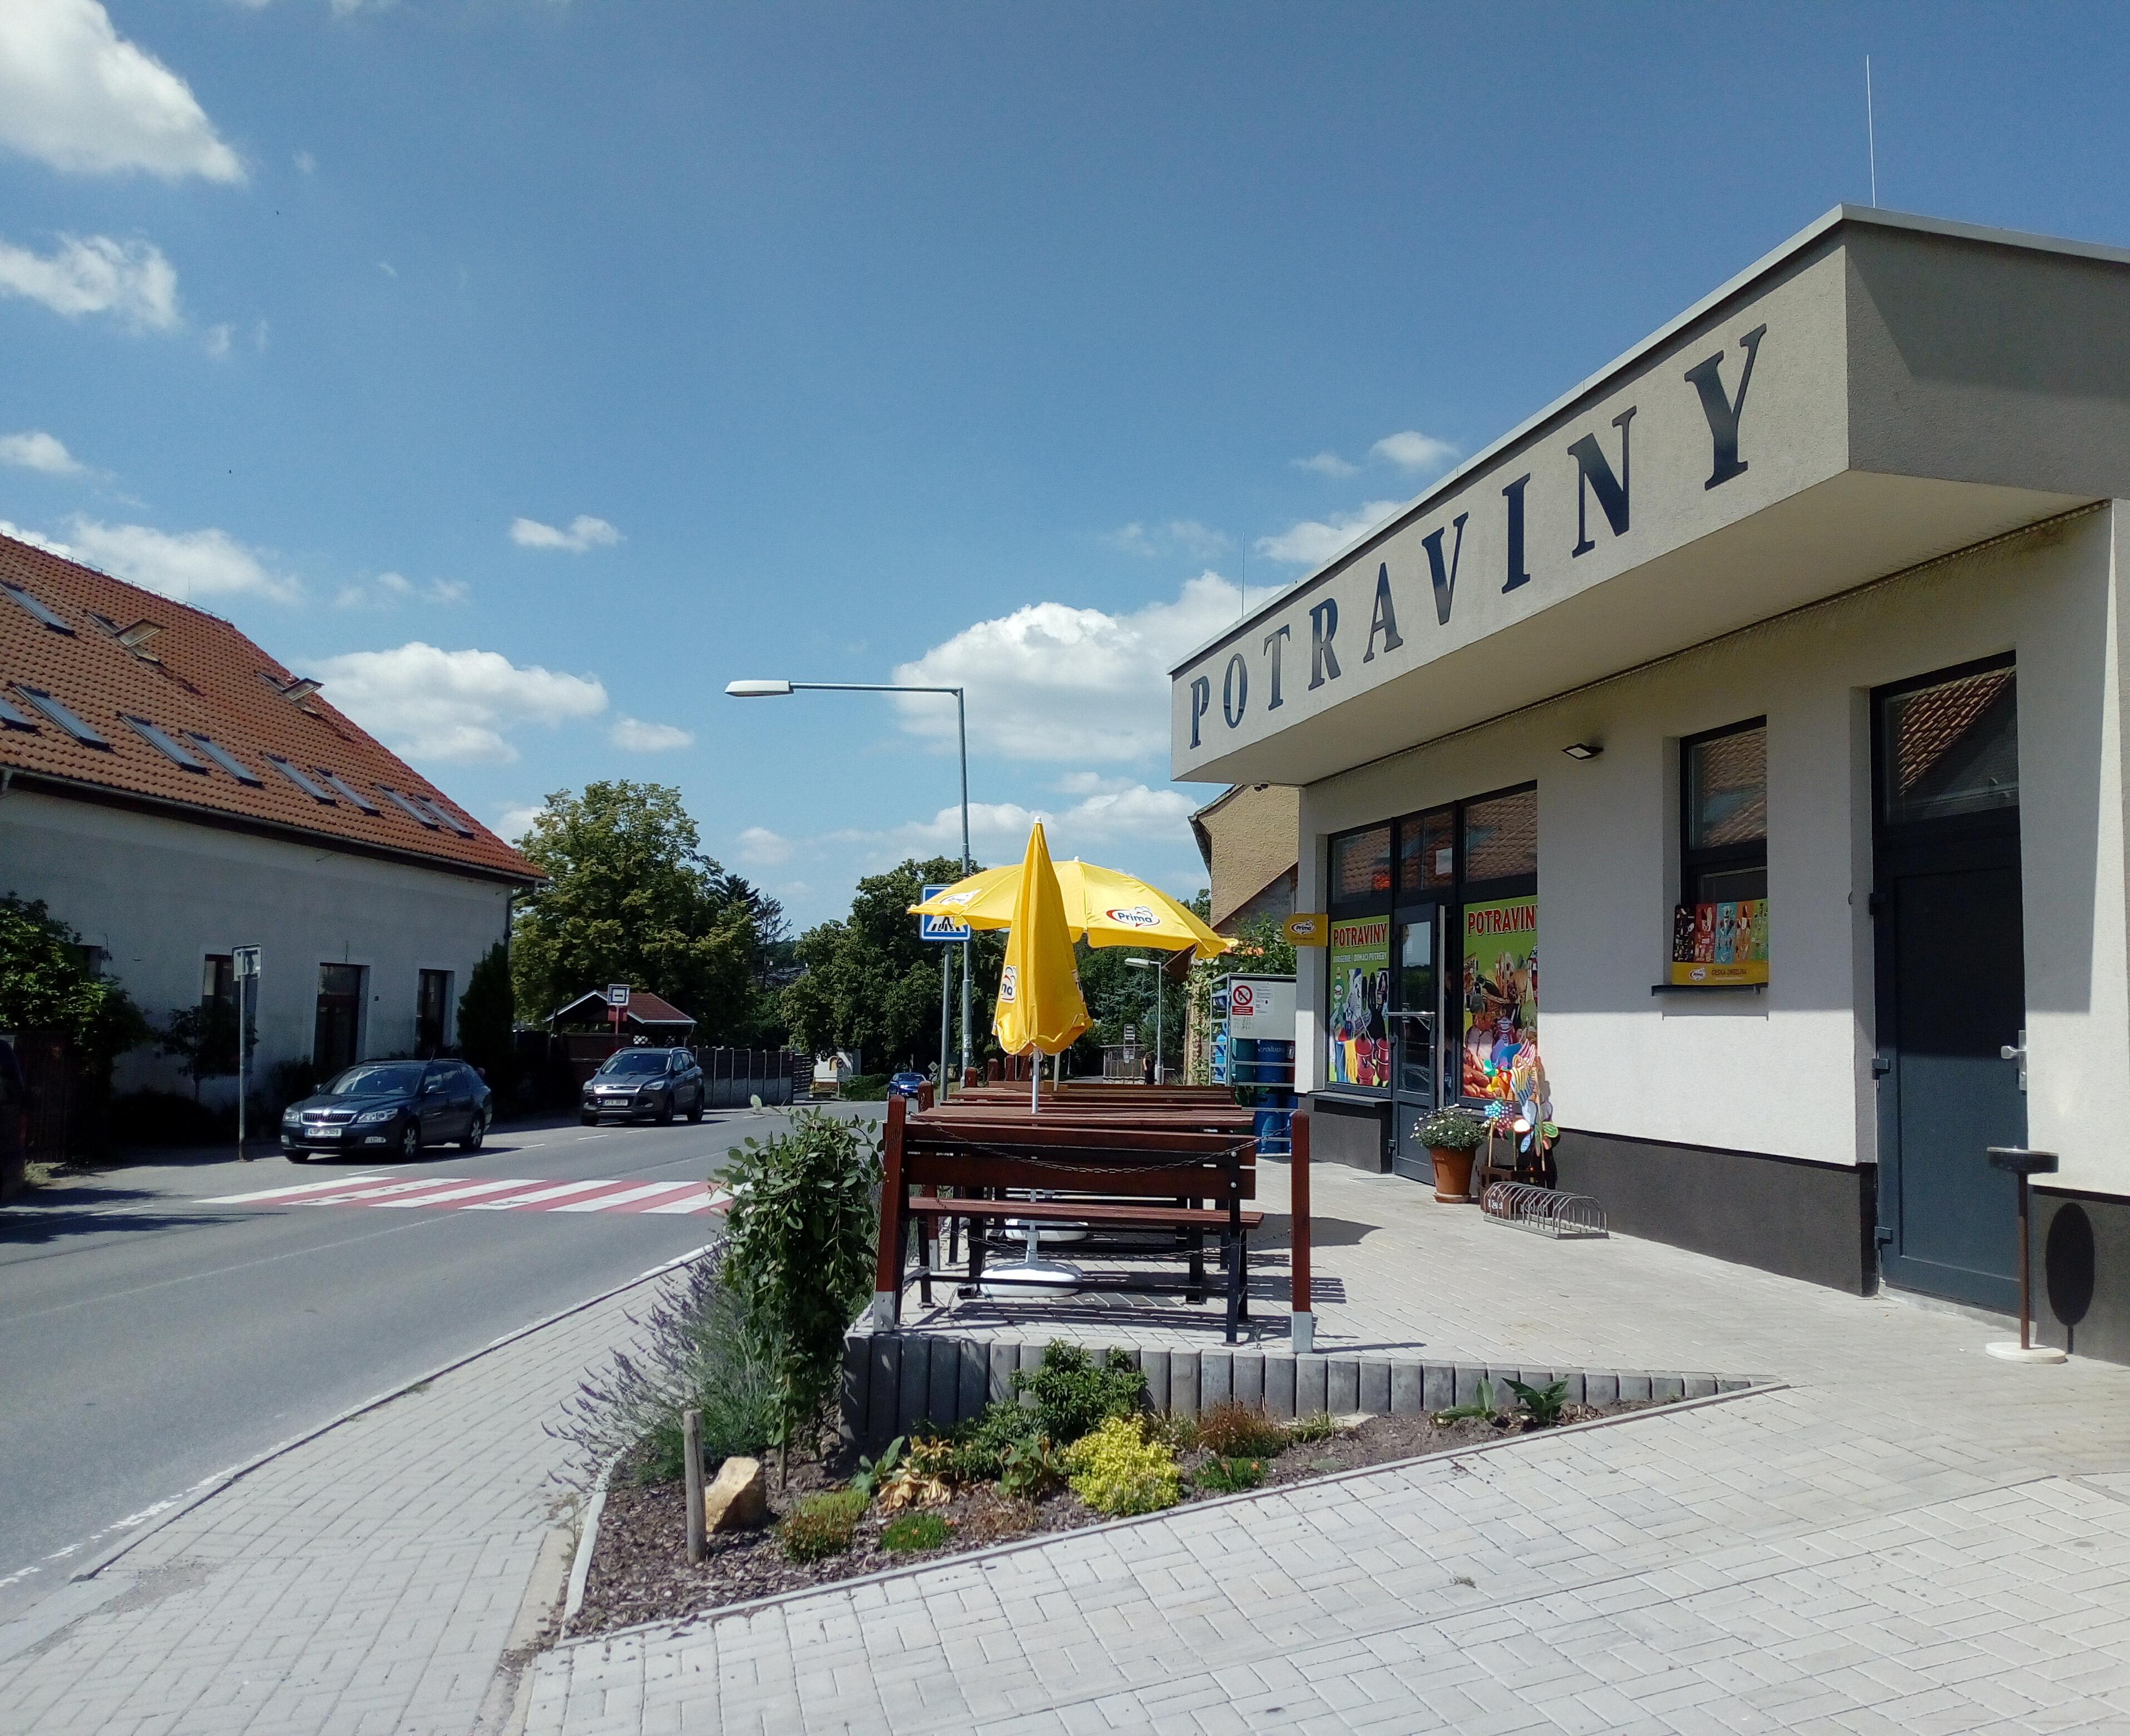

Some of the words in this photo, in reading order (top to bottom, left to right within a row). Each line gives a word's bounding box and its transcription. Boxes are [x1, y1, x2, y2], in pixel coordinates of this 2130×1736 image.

[1189, 323, 1767, 751] POTRAVINY
[1117, 912, 1153, 923] Prima
[1467, 904, 1537, 936] POTRAVIN
[1333, 922, 1388, 948] POTRAVINY
